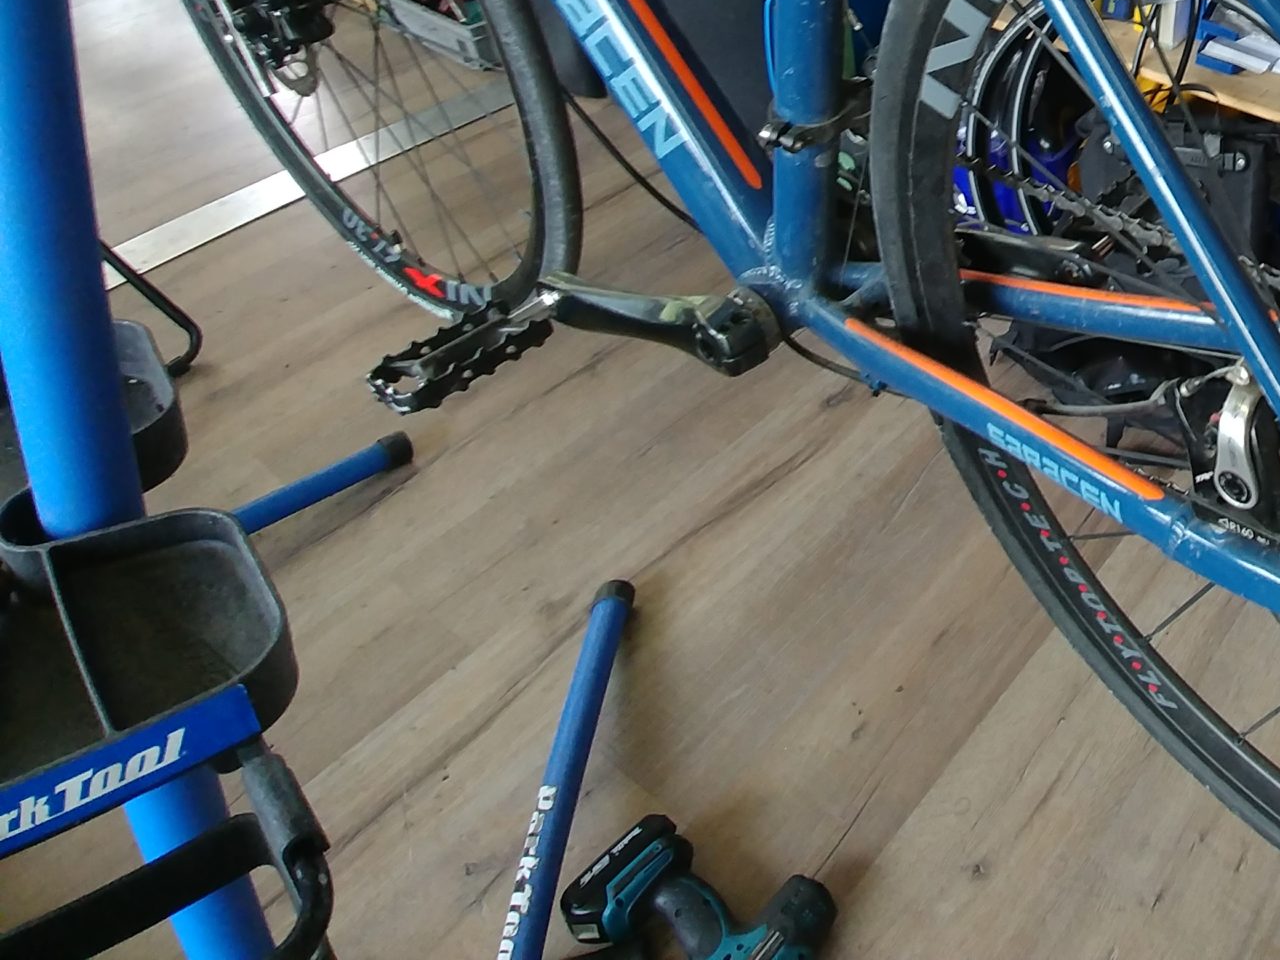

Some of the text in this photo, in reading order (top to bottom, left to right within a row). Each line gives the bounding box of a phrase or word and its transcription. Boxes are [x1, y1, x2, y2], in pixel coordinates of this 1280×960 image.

[0, 726, 187, 842] rk Tool
[497, 883, 533, 960] Too
